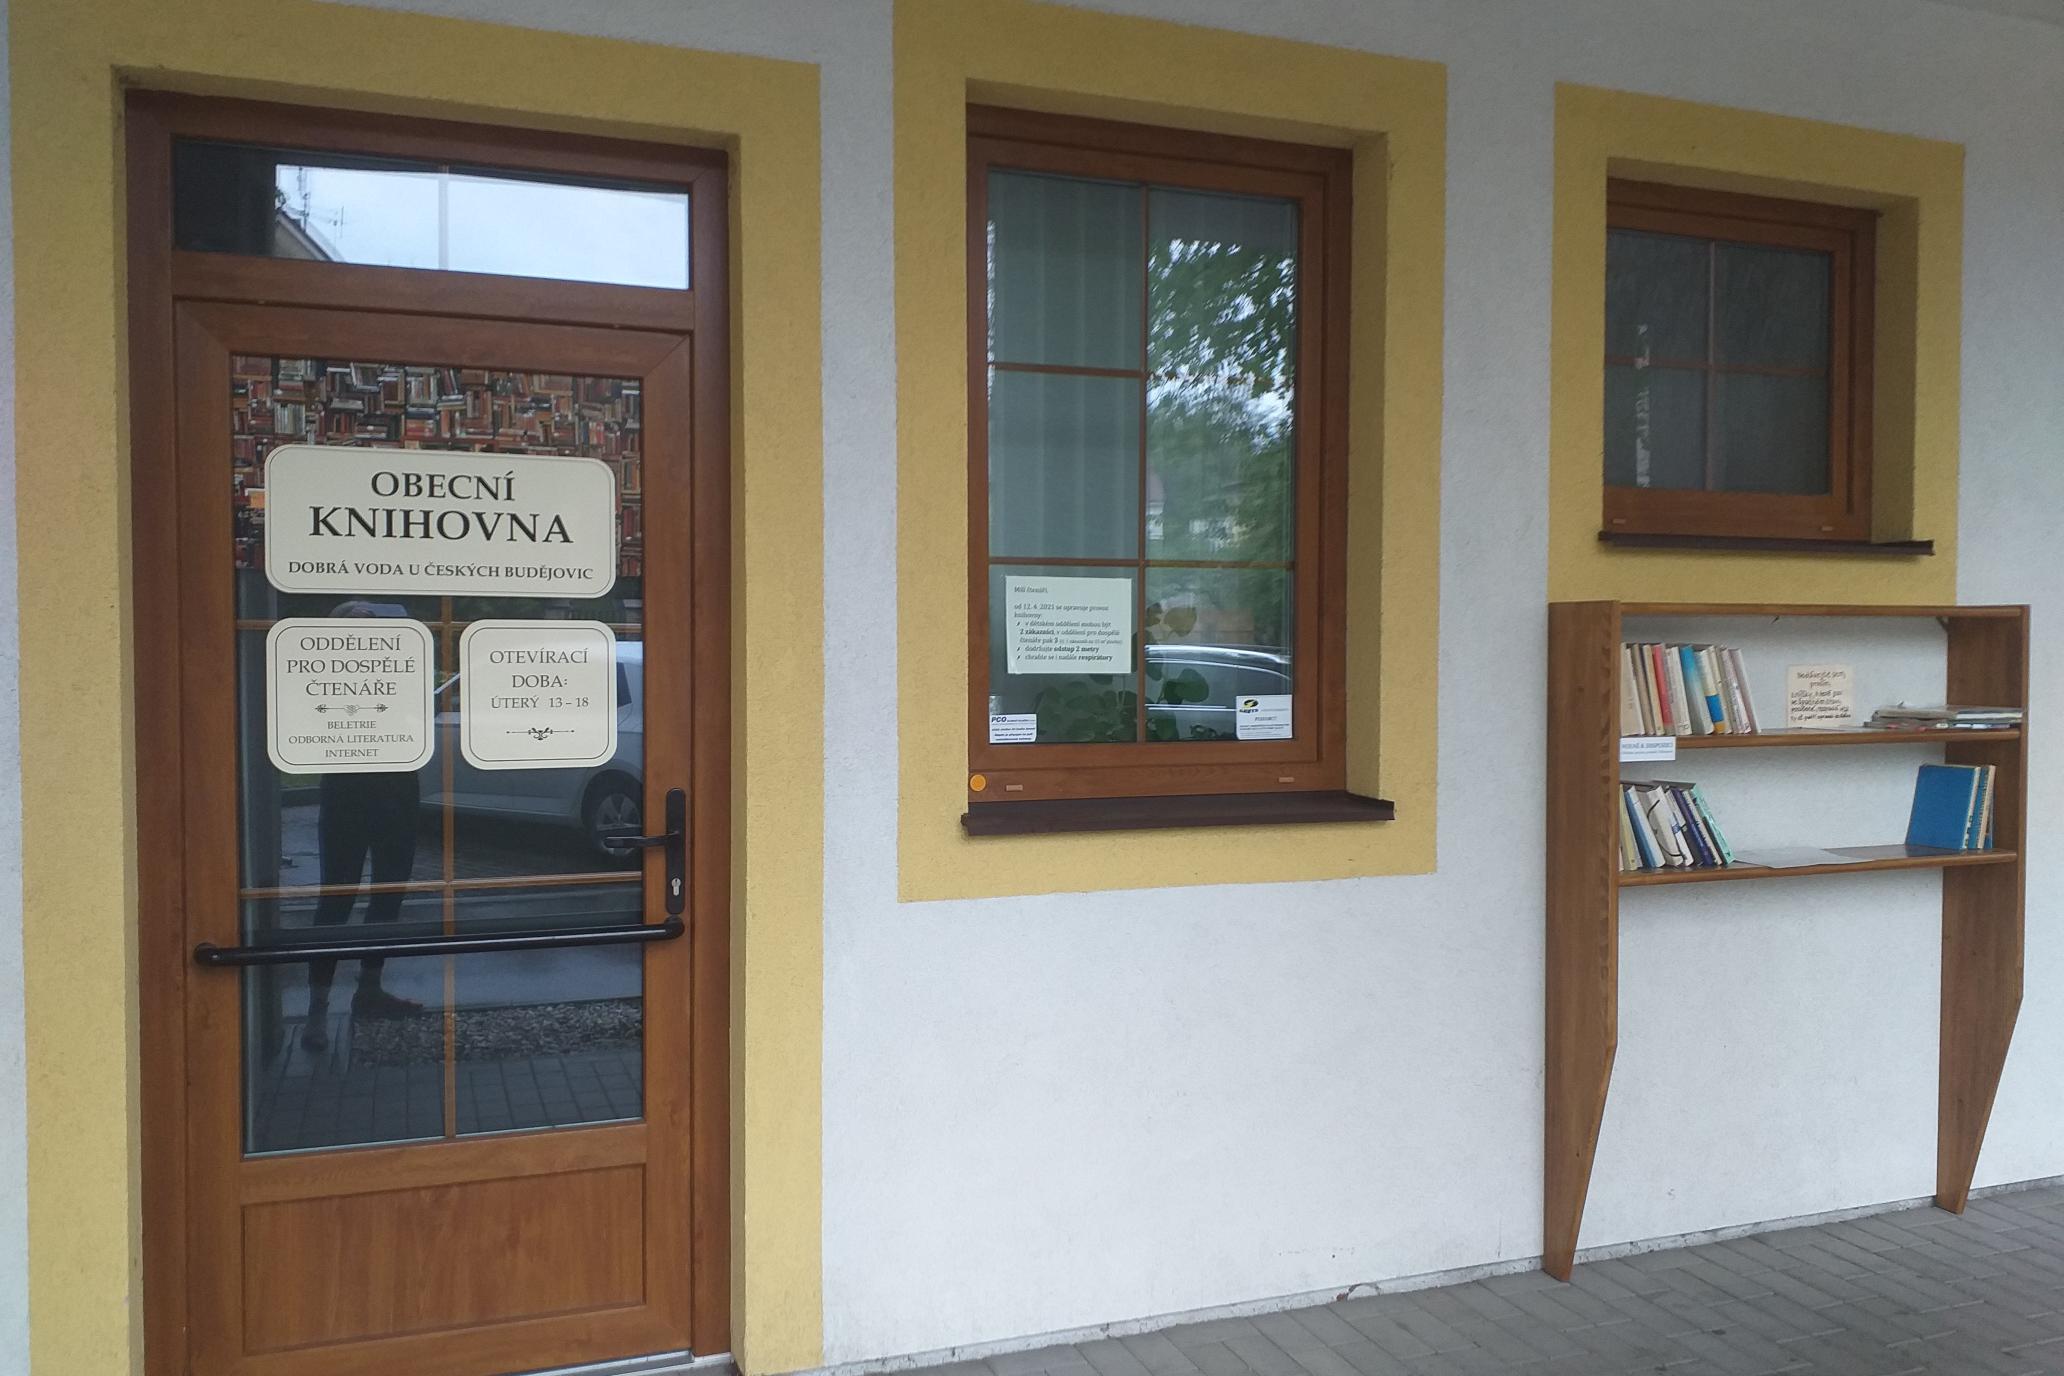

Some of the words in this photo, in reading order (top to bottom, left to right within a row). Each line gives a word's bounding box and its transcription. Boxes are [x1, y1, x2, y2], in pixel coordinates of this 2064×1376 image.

[371, 470, 515, 501] OBECNÍ
[308, 505, 574, 543] KNIHOVNA
[288, 560, 350, 574] DOBRÁ
[354, 562, 404, 575] VODA
[409, 564, 420, 575] U
[424, 562, 500, 577] ČESKÝCH
[505, 565, 593, 581] BUDĚJOVIC
[300, 634, 401, 651] ODDĚLENÍ
[489, 647, 589, 664] OTEVÍRACÍ
[287, 659, 326, 673] PRO
[331, 656, 416, 673] DOSPĚLÉ
[305, 679, 397, 696] ČTENÁŘE
[512, 675, 568, 688] DOBA:
[491, 695, 540, 709] ÚTERÝ
[550, 697, 563, 708] 13
[576, 697, 589, 707] 18
[327, 720, 377, 730] BELETRIE
[347, 734, 414, 744] LITERATURA
[325, 749, 380, 758] INTERNET
